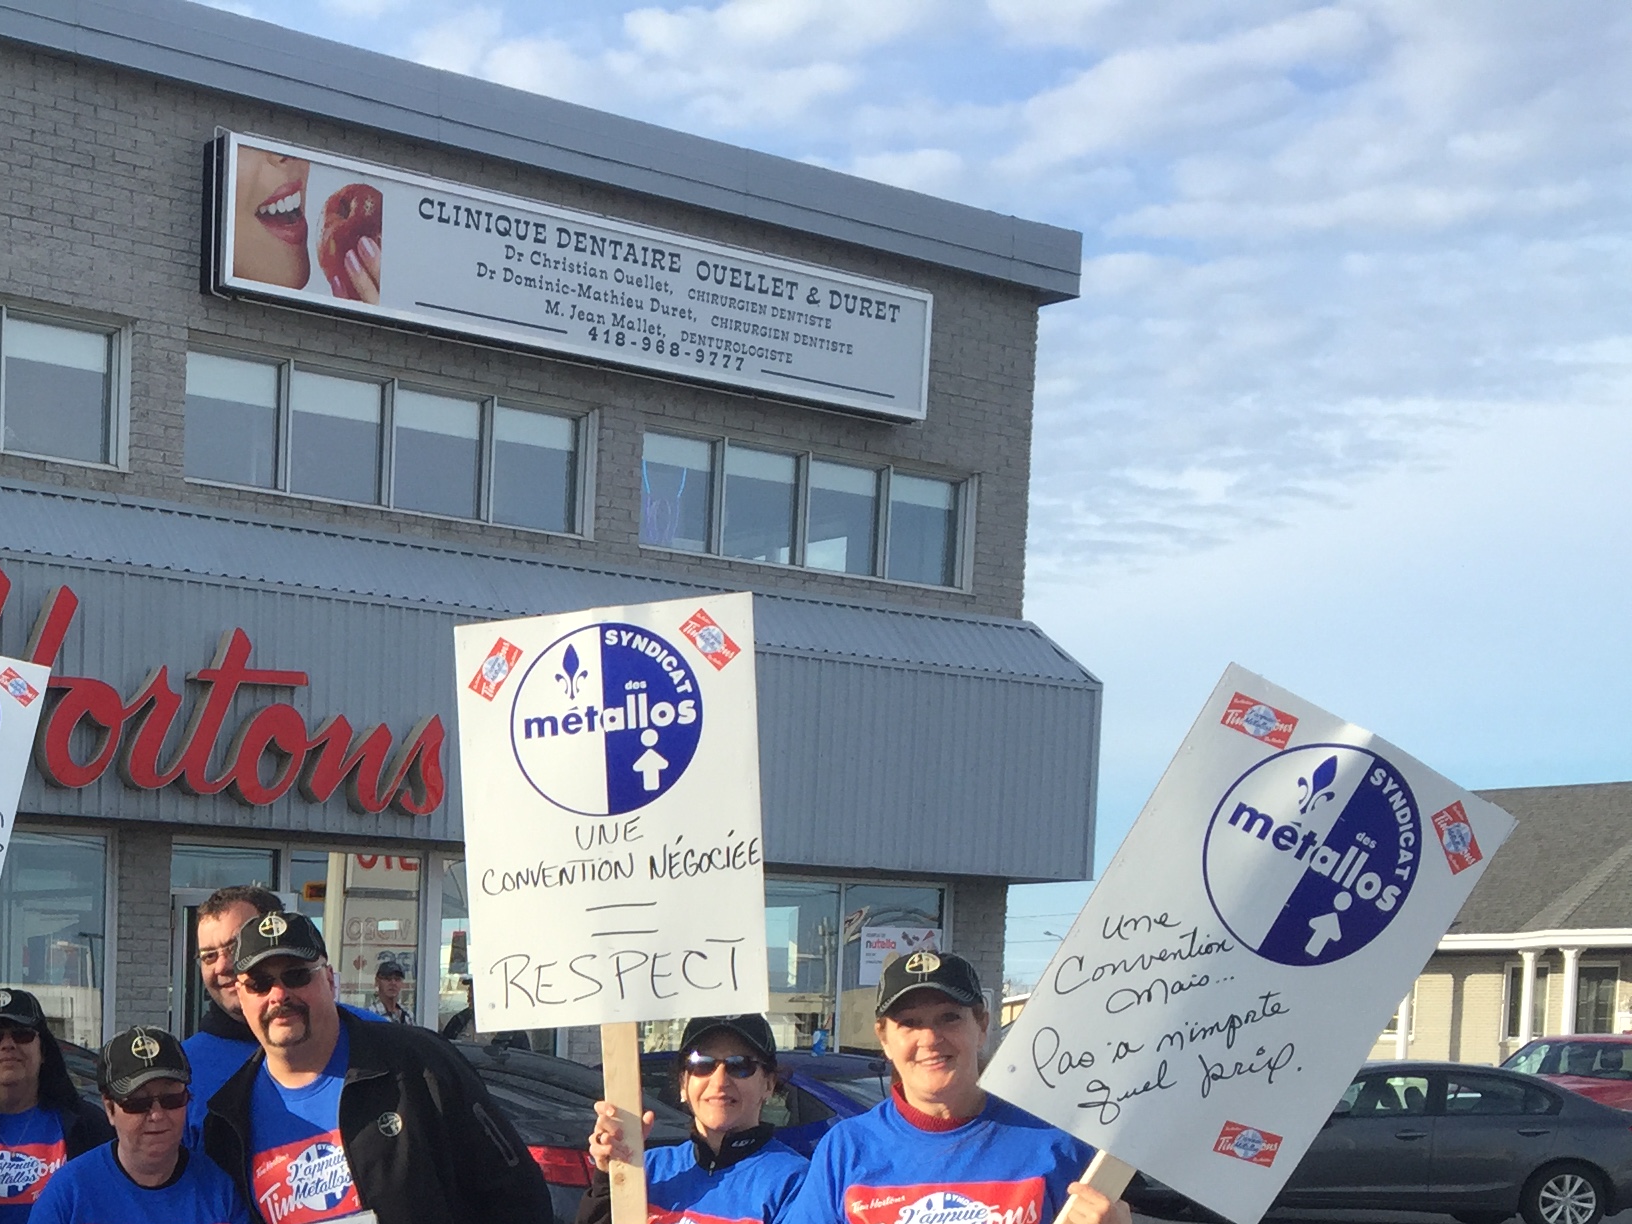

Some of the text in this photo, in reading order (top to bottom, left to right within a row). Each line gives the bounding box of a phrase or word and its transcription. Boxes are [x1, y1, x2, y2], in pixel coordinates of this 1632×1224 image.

[418, 197, 901, 323] CLINIQUE DENTAIRE OUELLET & DURET
[505, 245, 832, 330] Dr Christian Ouellet, CHIRURGIEN DENTISTE
[476, 261, 854, 355] Dr Dominic-Mathieu Duret, CHIRURGIEN DENTISTE
[545, 299, 793, 364] M. Jean Mallet, DENTUROLOGISTE
[588, 326, 745, 372] 418-968-9777
[605, 629, 693, 695] SYNDICAT
[624, 679, 647, 691] des
[524, 694, 698, 741] métallos
[575, 815, 645, 852] UNE
[1228, 800, 1403, 913] métallos
[1354, 831, 1378, 850] des
[1370, 766, 1415, 883] SYNDICAT
[481, 829, 761, 897] CONVENTION NÉGOCIÉE
[489, 937, 746, 1011] RESPECT
